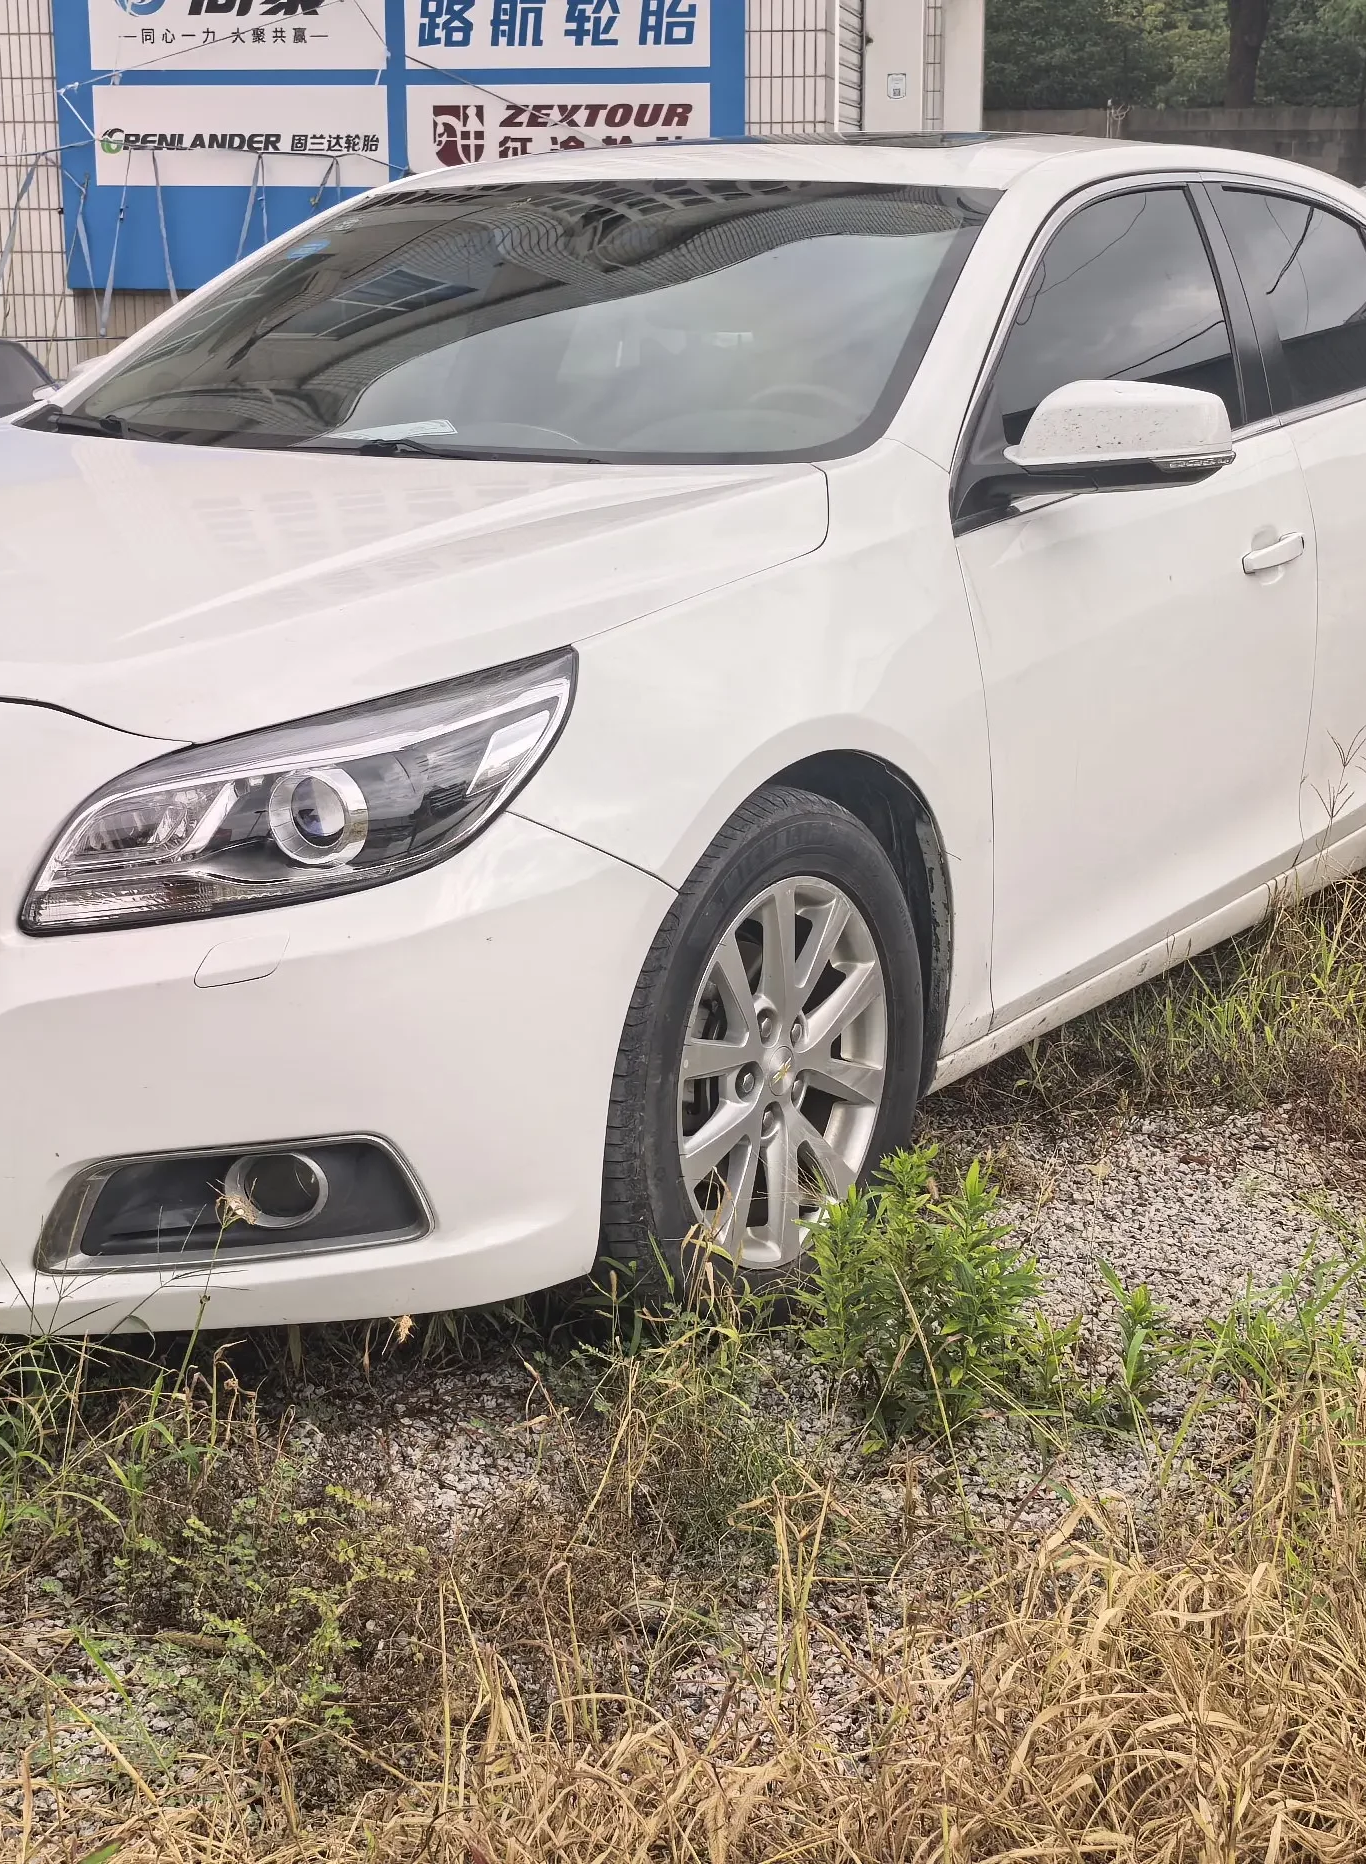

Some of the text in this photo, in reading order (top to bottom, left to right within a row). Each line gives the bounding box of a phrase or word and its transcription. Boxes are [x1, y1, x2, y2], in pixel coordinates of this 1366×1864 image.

[418, 0, 698, 47] 路航轮胎
[141, 27, 308, 44] 同心一力 大聚共赢
[499, 103, 693, 128] ZEXTOUR
[291, 134, 380, 152] 固兰达轮胎
